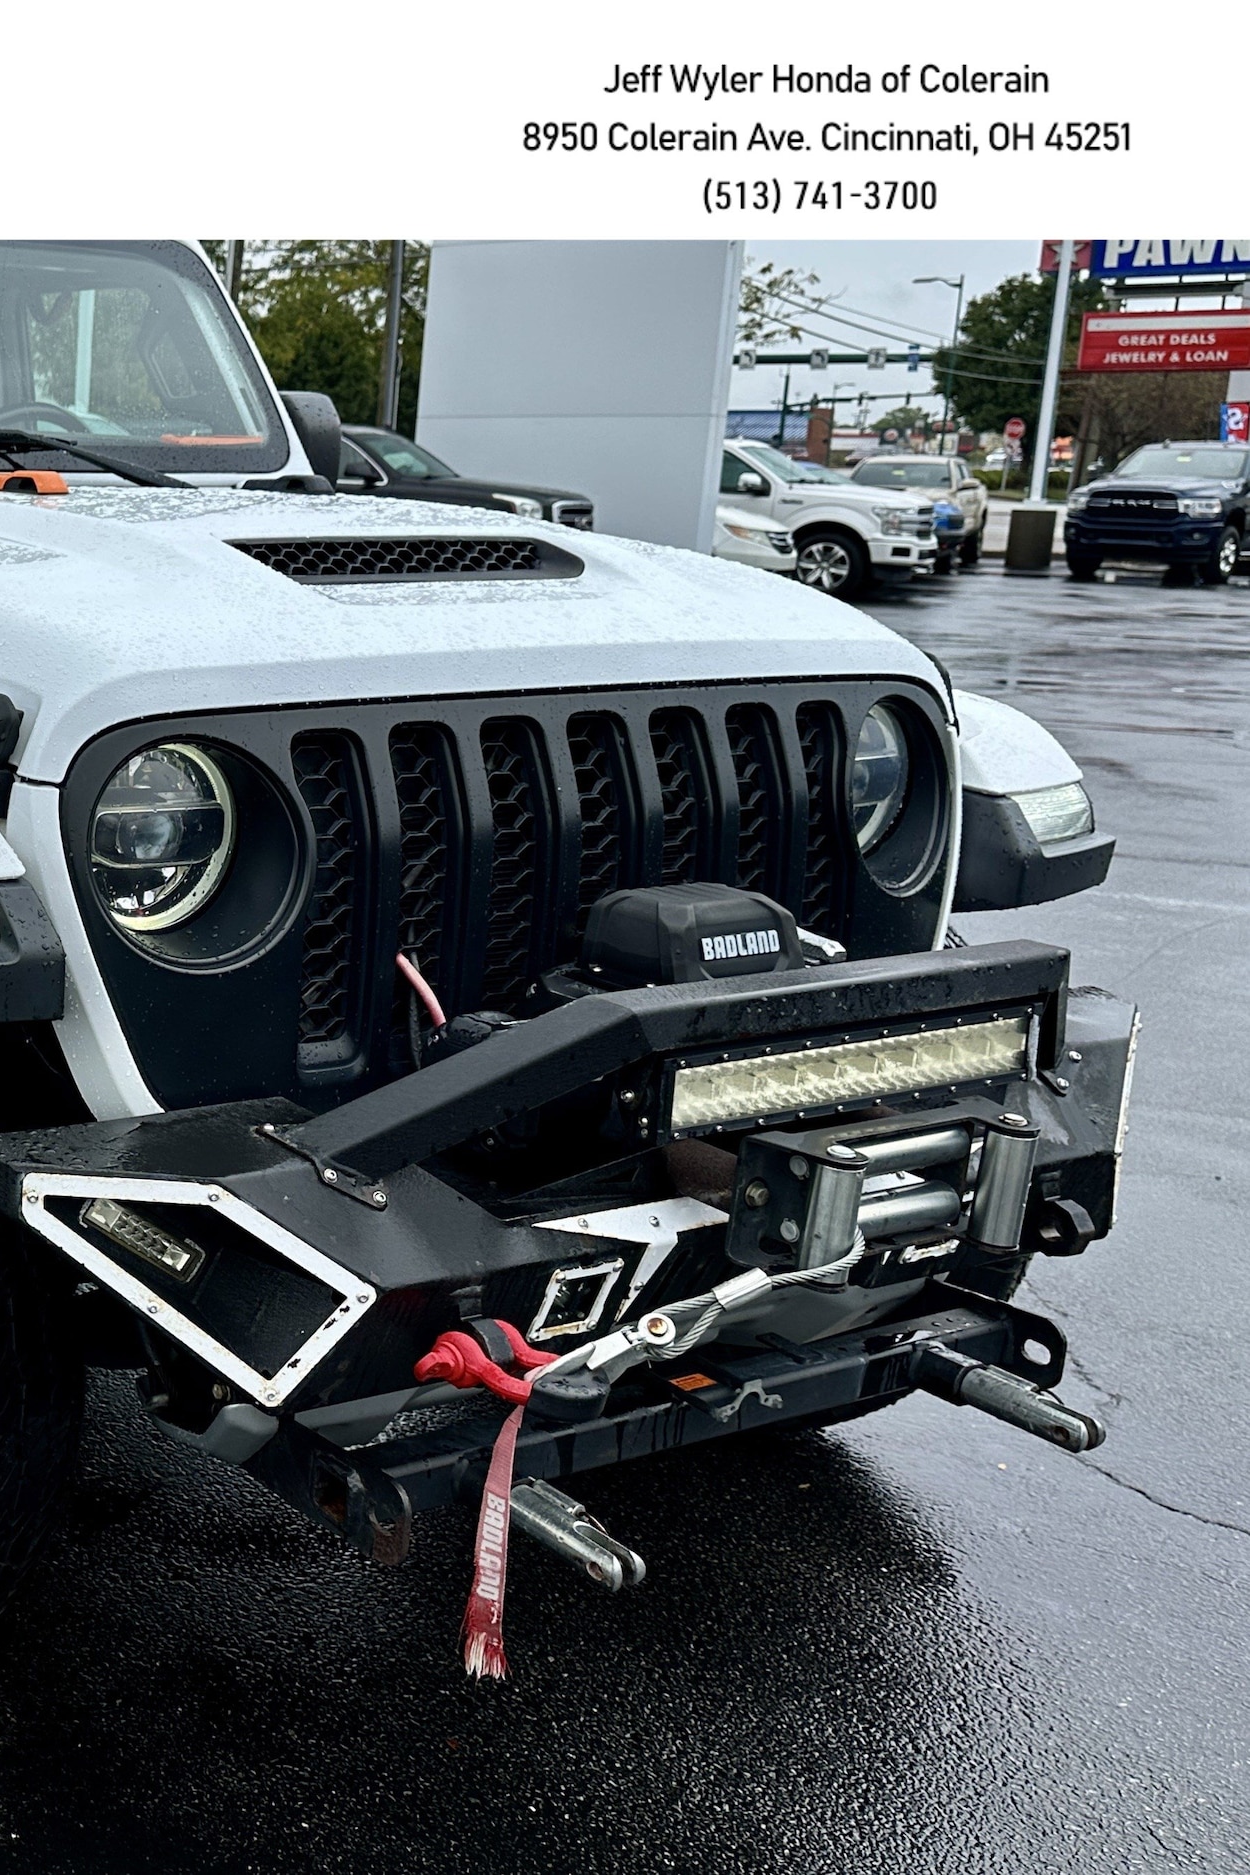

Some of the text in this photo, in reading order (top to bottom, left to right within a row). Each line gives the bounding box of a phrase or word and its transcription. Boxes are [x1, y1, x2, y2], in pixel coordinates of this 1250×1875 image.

[1117, 333, 1217, 347] GREAT DEALS
[1103, 350, 1229, 364] JEWELRY & LOAN
[701, 929, 780, 961] BADLAND
[476, 1491, 506, 1601] BADLAND
